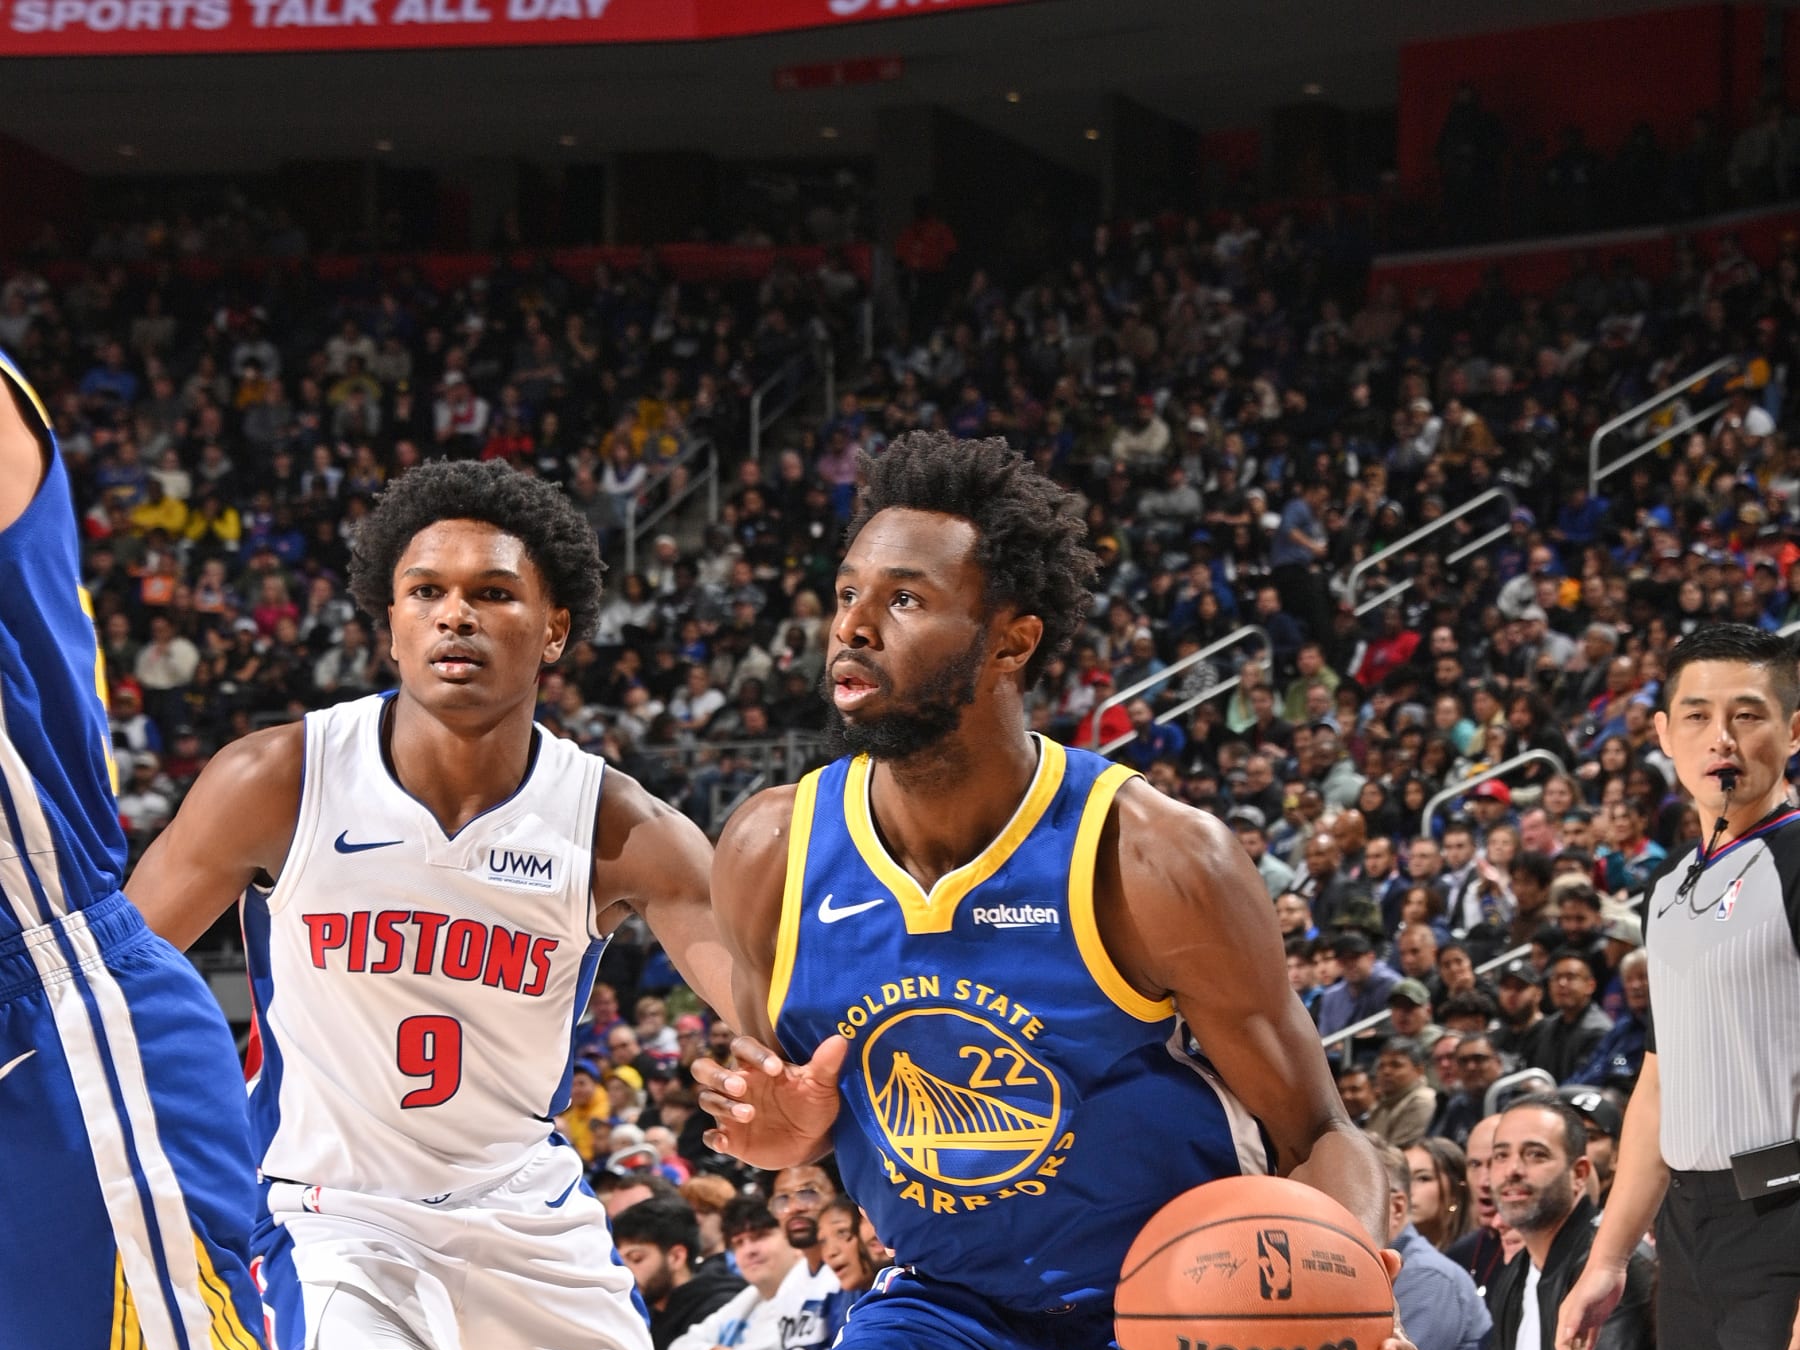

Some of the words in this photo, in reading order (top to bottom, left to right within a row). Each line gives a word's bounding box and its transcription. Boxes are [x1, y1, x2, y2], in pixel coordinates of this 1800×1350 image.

[11, 0, 230, 32] SPORTS
[249, 0, 378, 27] TALK
[392, 0, 492, 24] ALL
[507, 0, 608, 21] DAY
[490, 850, 552, 880] UWM
[973, 904, 1060, 925] Rakuten
[302, 910, 559, 996] PISTONS
[837, 976, 940, 1040] GOLDEN
[954, 979, 1046, 1041] STATE
[396, 1015, 462, 1110] 9
[959, 1045, 1038, 1089] 22
